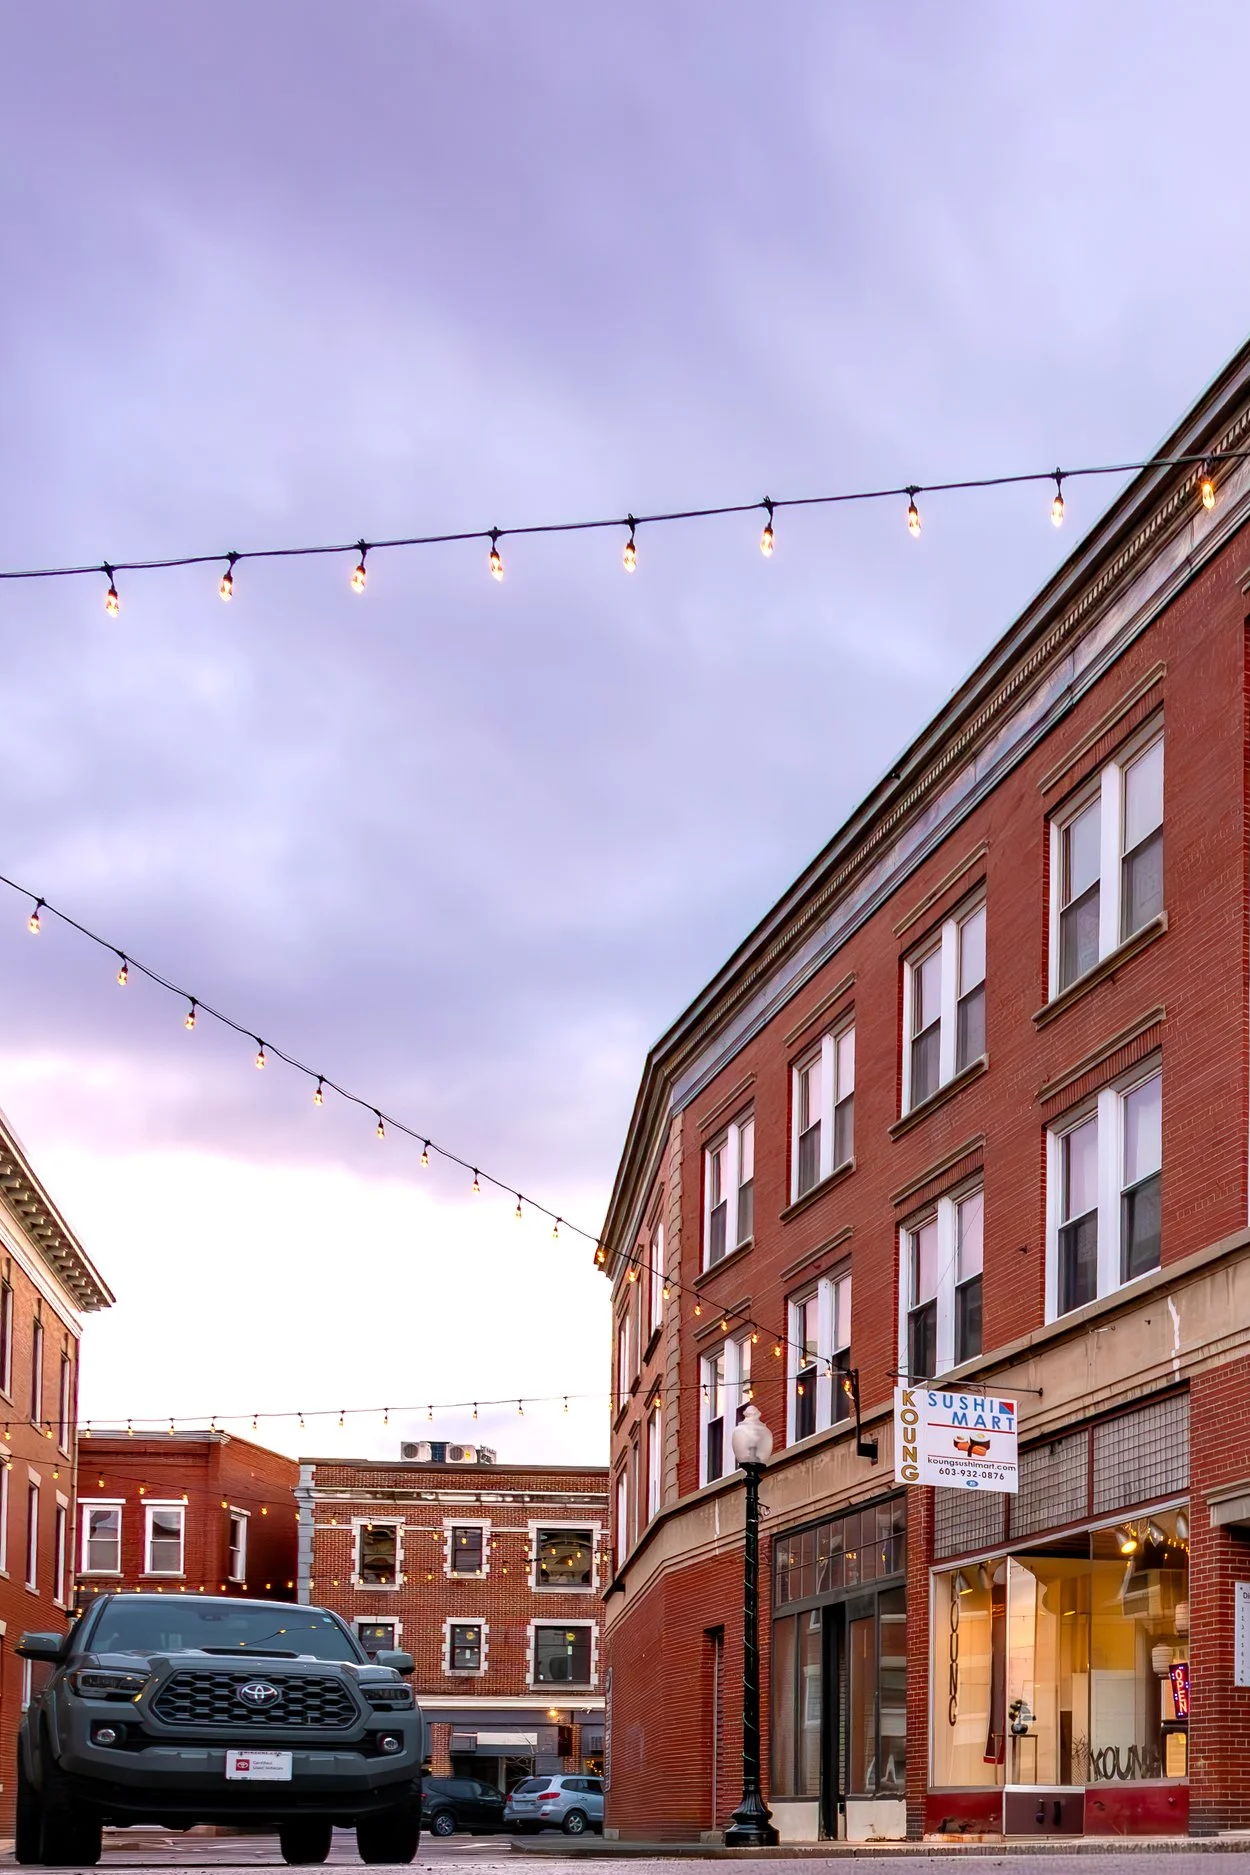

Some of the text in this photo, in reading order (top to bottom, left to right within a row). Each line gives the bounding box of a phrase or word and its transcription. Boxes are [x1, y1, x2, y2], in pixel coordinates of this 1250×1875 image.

[928, 1392, 993, 1413] SUSHI
[951, 1411, 1014, 1431] MART
[900, 1389, 919, 1482] KOUNG
[927, 1457, 1016, 1472] koungsushimart.com
[938, 1467, 1005, 1480] 603-932-0876
[1175, 1669, 1187, 1713] OPEN
